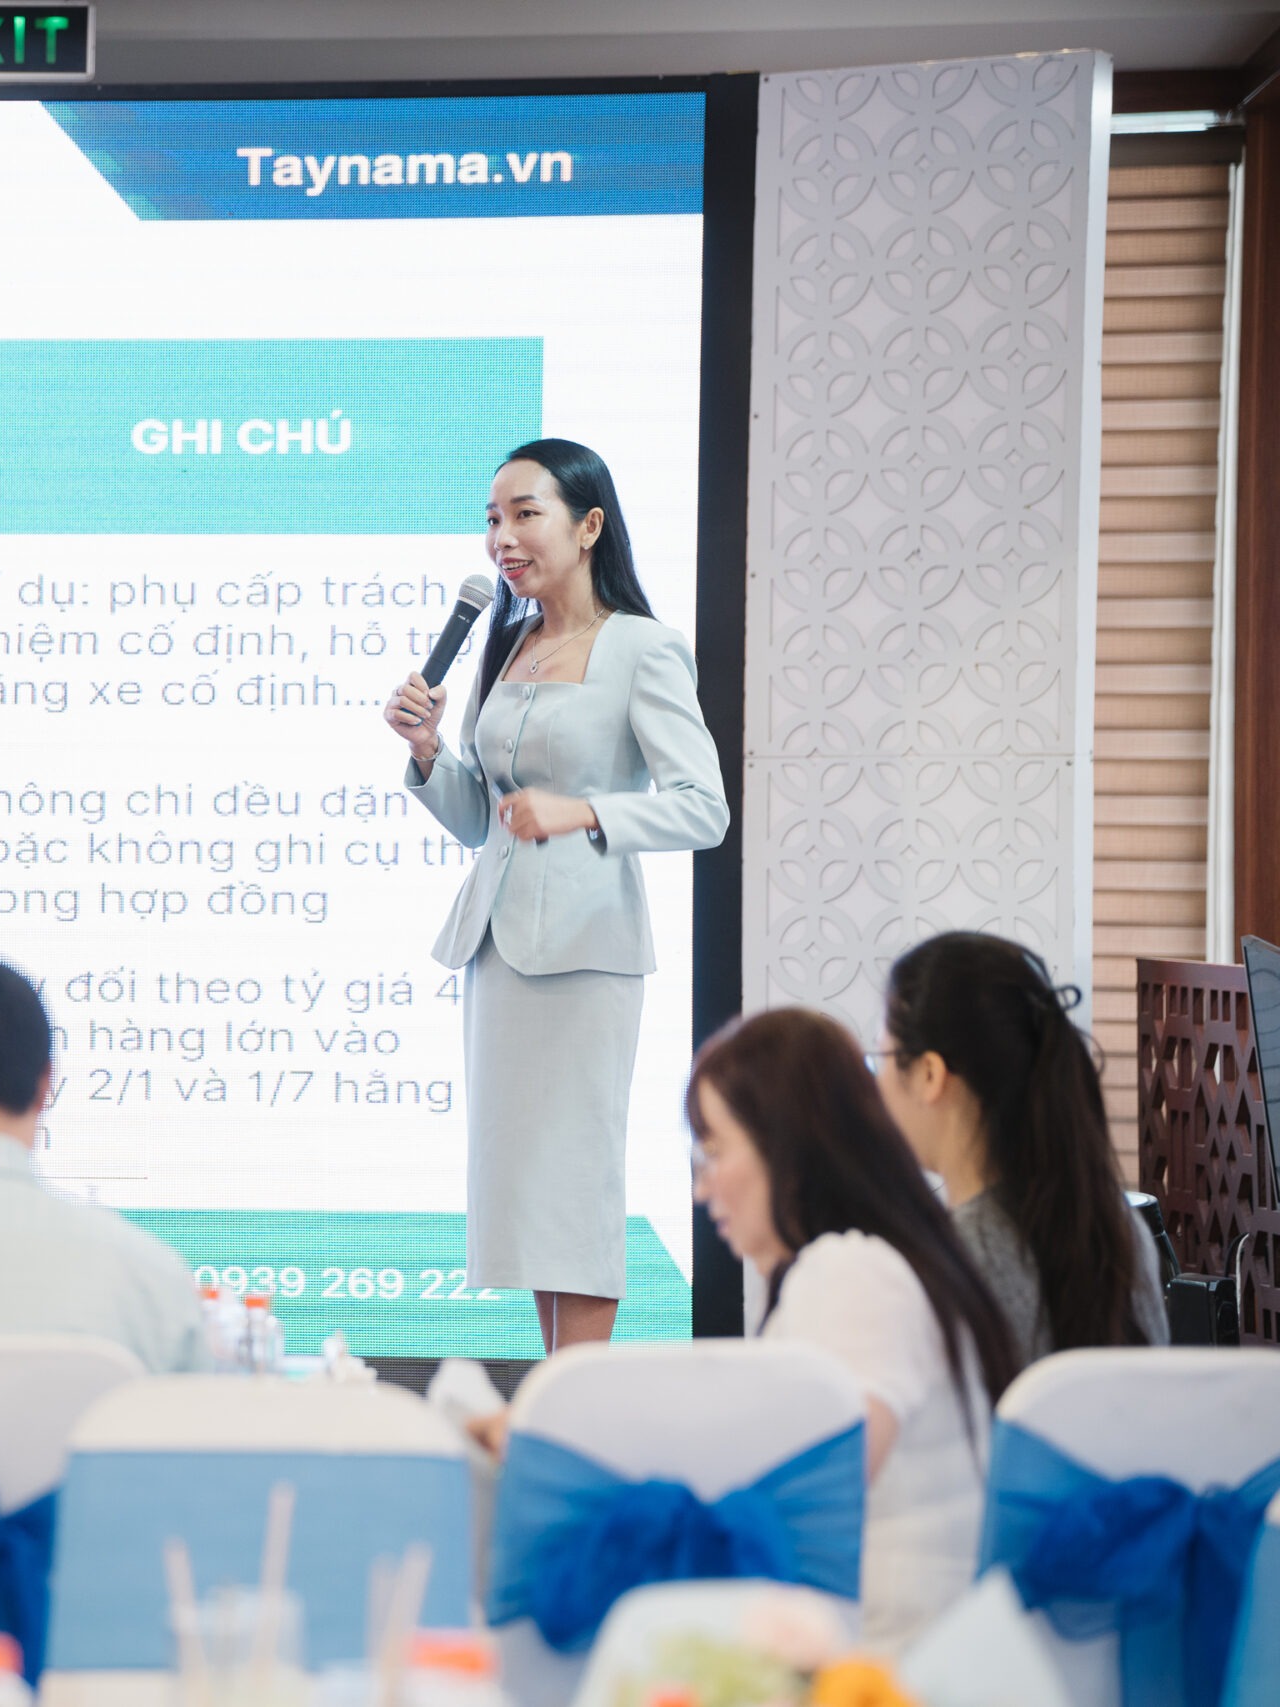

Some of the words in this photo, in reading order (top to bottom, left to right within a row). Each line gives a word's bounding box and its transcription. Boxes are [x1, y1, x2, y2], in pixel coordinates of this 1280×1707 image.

[236, 146, 573, 197] Taynama.vn
[131, 418, 223, 455] GHI
[236, 409, 353, 455] CHÚ
[17, 574, 89, 613] dụ:
[109, 574, 197, 615] phụ
[216, 571, 303, 616] cấp
[322, 572, 447, 608] trách
[118, 620, 175, 657] cố
[192, 623, 308, 663] định,
[89, 681, 143, 706] xe
[161, 669, 218, 706] cố
[126, 783, 193, 816] chi
[213, 780, 301, 817] đều
[88, 830, 235, 873] không
[254, 832, 325, 873] ghi
[344, 840, 400, 871] cụ
[420, 834, 482, 868] th
[100, 882, 189, 923] hợp
[207, 880, 328, 924] đồng
[157, 972, 263, 1004] theo
[344, 971, 414, 1014] giá
[89, 1018, 206, 1063] hàng
[225, 1019, 294, 1053] lớn
[314, 1020, 401, 1055] vào
[88, 1068, 152, 1105] 2/1
[174, 1067, 228, 1102] và
[248, 1070, 315, 1107] 1/7
[321, 1267, 408, 1301] 269
[419, 1268, 503, 1302] 22
